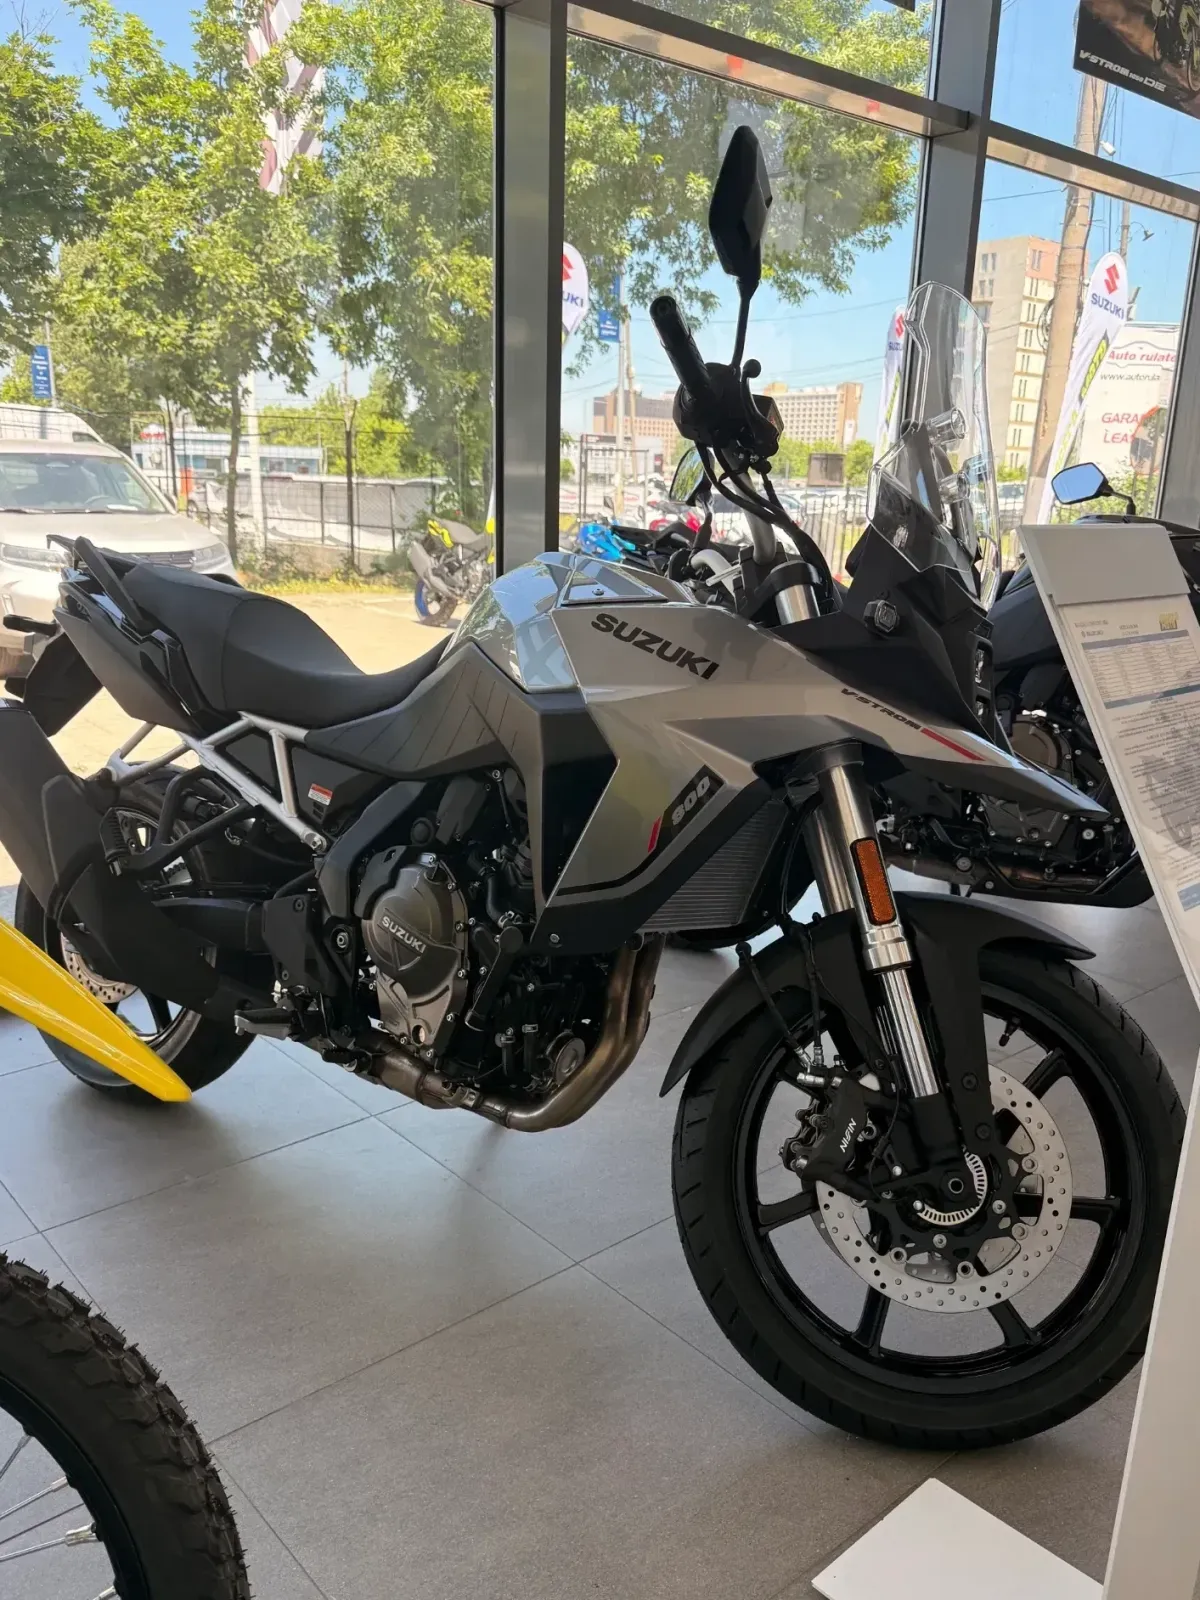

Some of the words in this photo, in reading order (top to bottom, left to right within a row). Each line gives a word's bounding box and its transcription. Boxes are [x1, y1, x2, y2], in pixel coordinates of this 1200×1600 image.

[1143, 76, 1167, 92] DE
[1091, 293, 1125, 319] SUZUKI
[1108, 350, 1137, 361] Auto
[591, 613, 720, 680] SUZUKI
[671, 775, 711, 826] 800
[381, 916, 427, 954] SUZUKI
